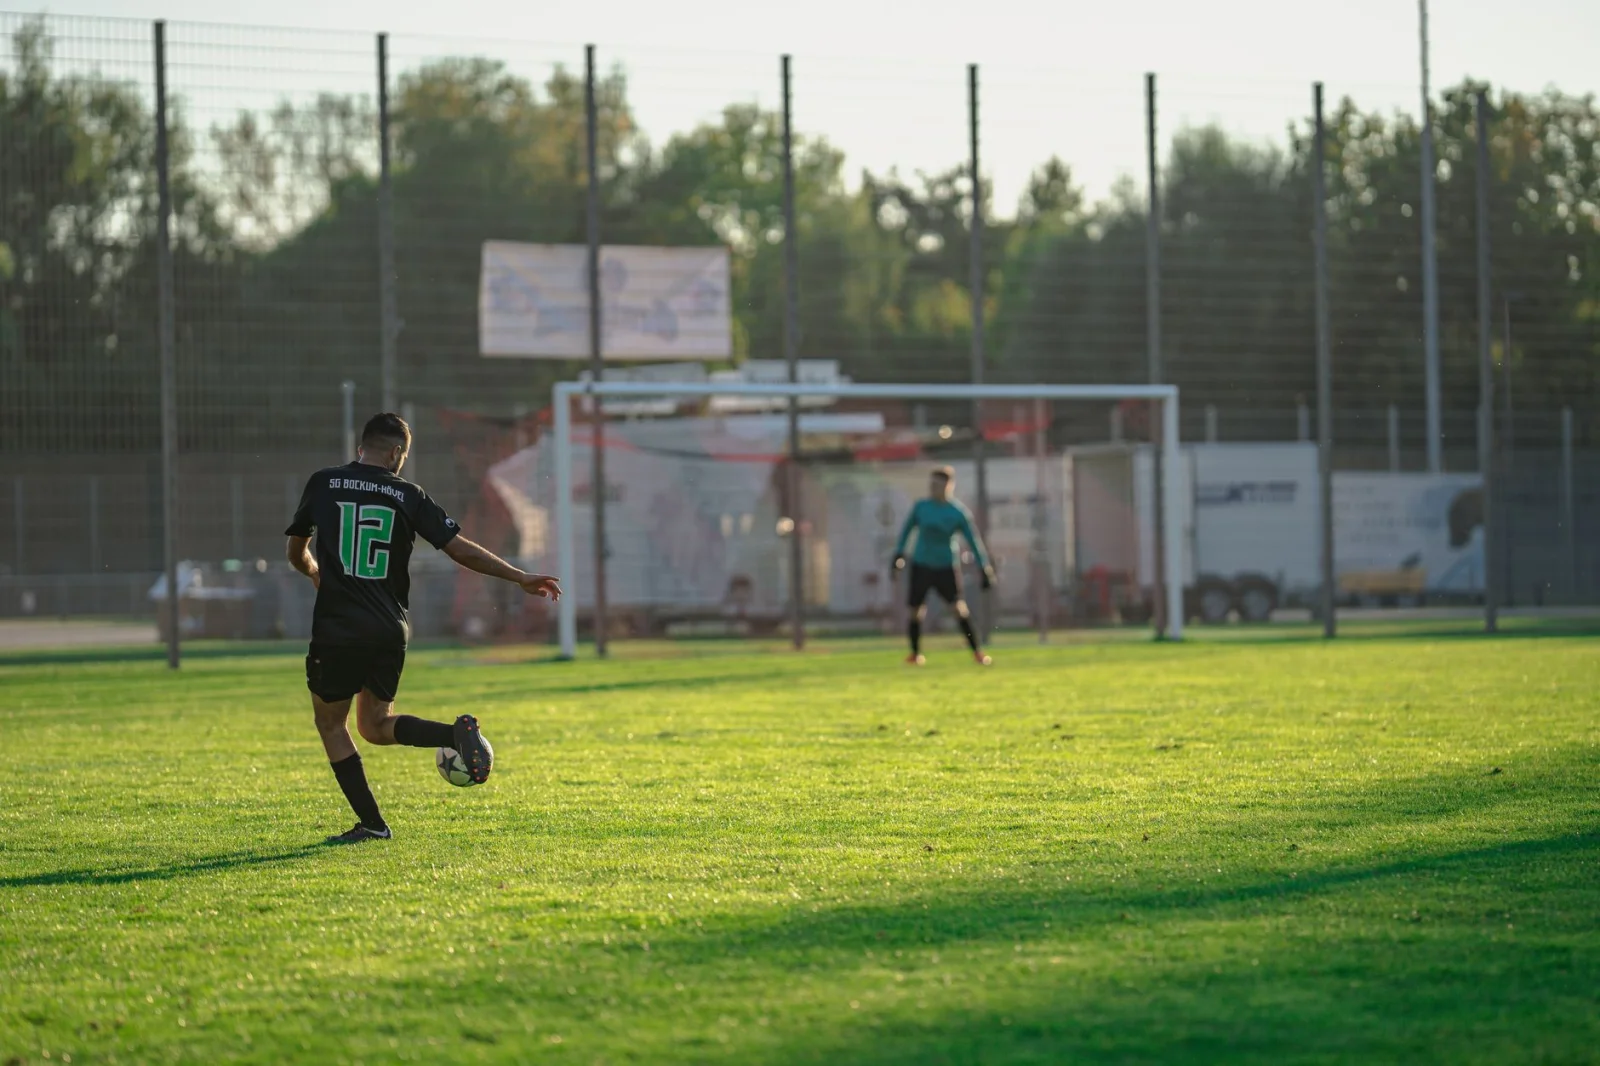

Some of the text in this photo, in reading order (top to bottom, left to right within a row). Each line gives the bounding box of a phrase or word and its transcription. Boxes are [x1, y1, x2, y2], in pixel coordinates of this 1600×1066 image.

[329, 478, 404, 502] SG BOCKUM-HÖVEL
[336, 502, 396, 579] 12
